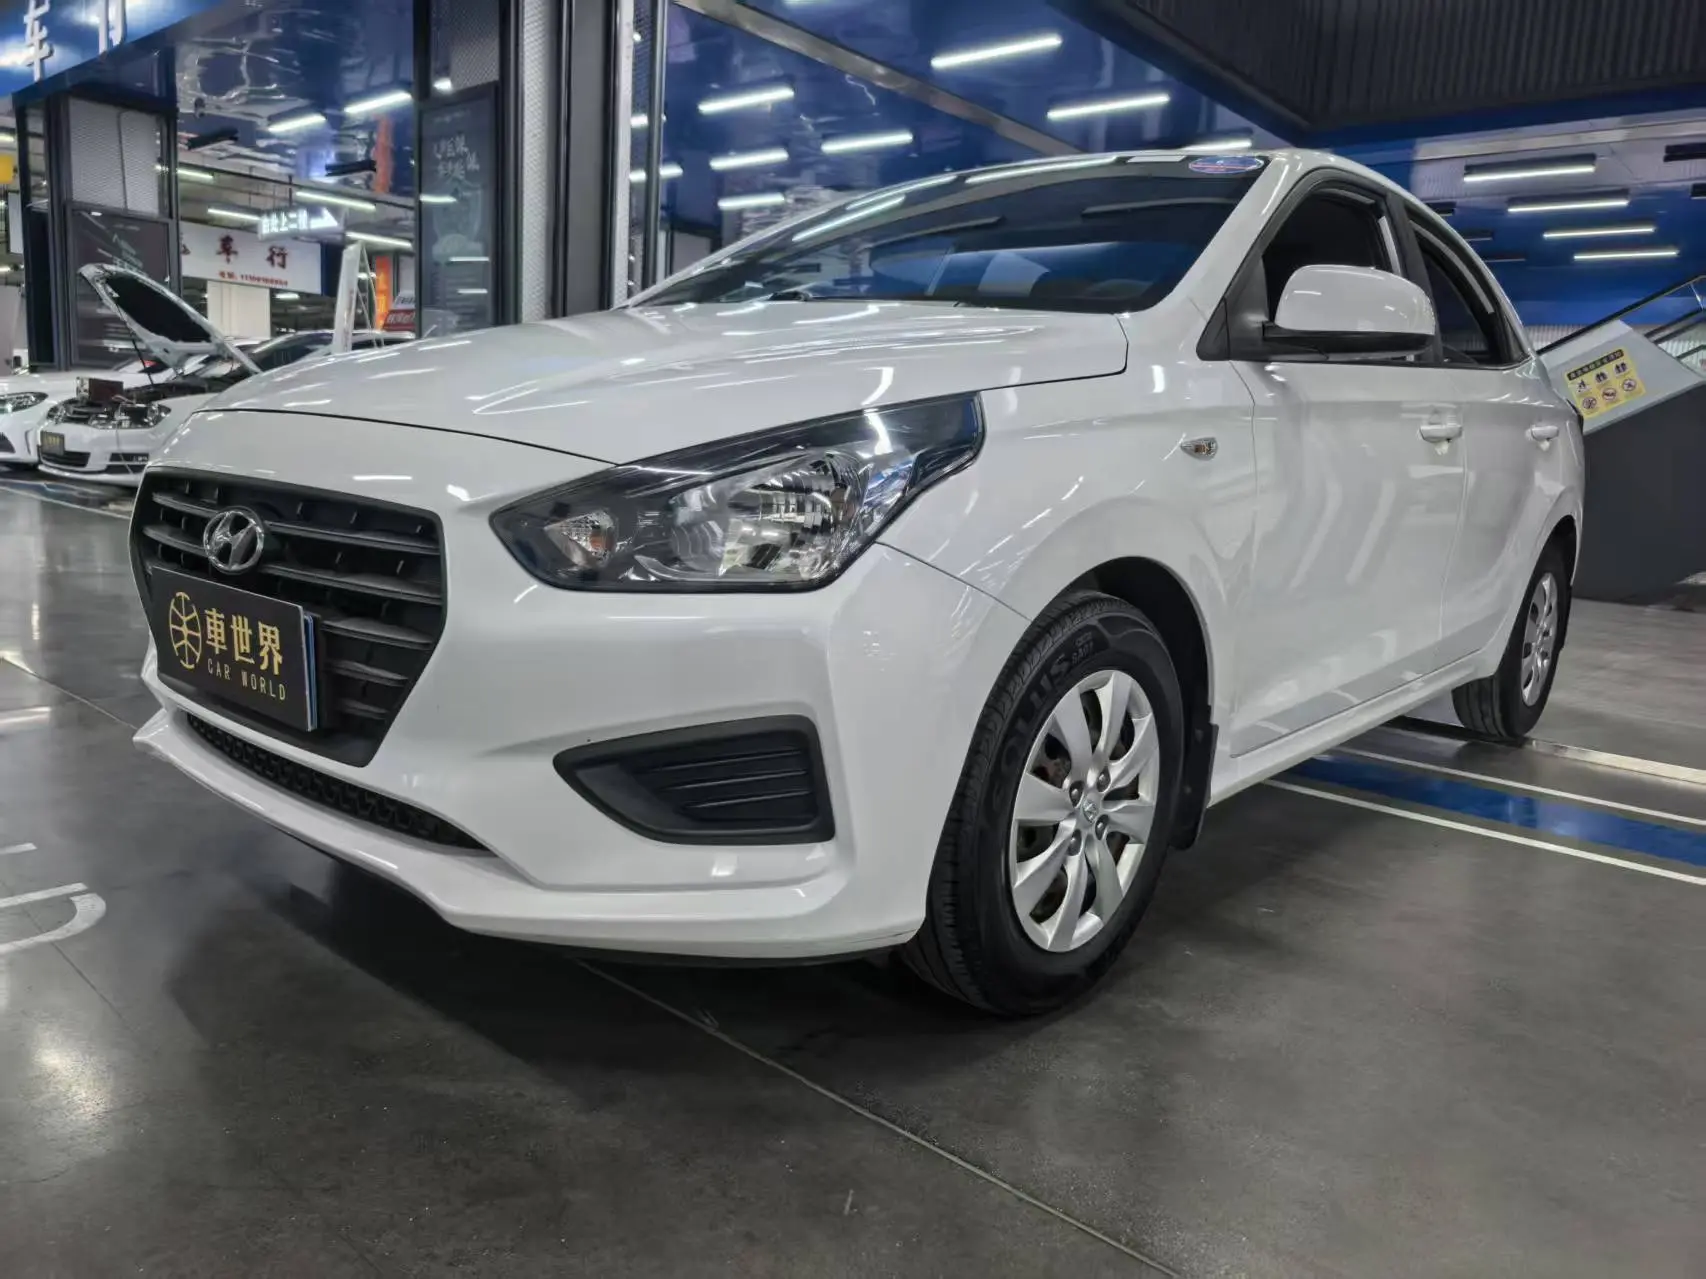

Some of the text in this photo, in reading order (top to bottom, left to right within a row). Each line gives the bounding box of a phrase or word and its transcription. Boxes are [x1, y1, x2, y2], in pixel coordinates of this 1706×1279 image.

[204, 607, 283, 675] 車世界
[207, 658, 287, 701] CAR WORLD
